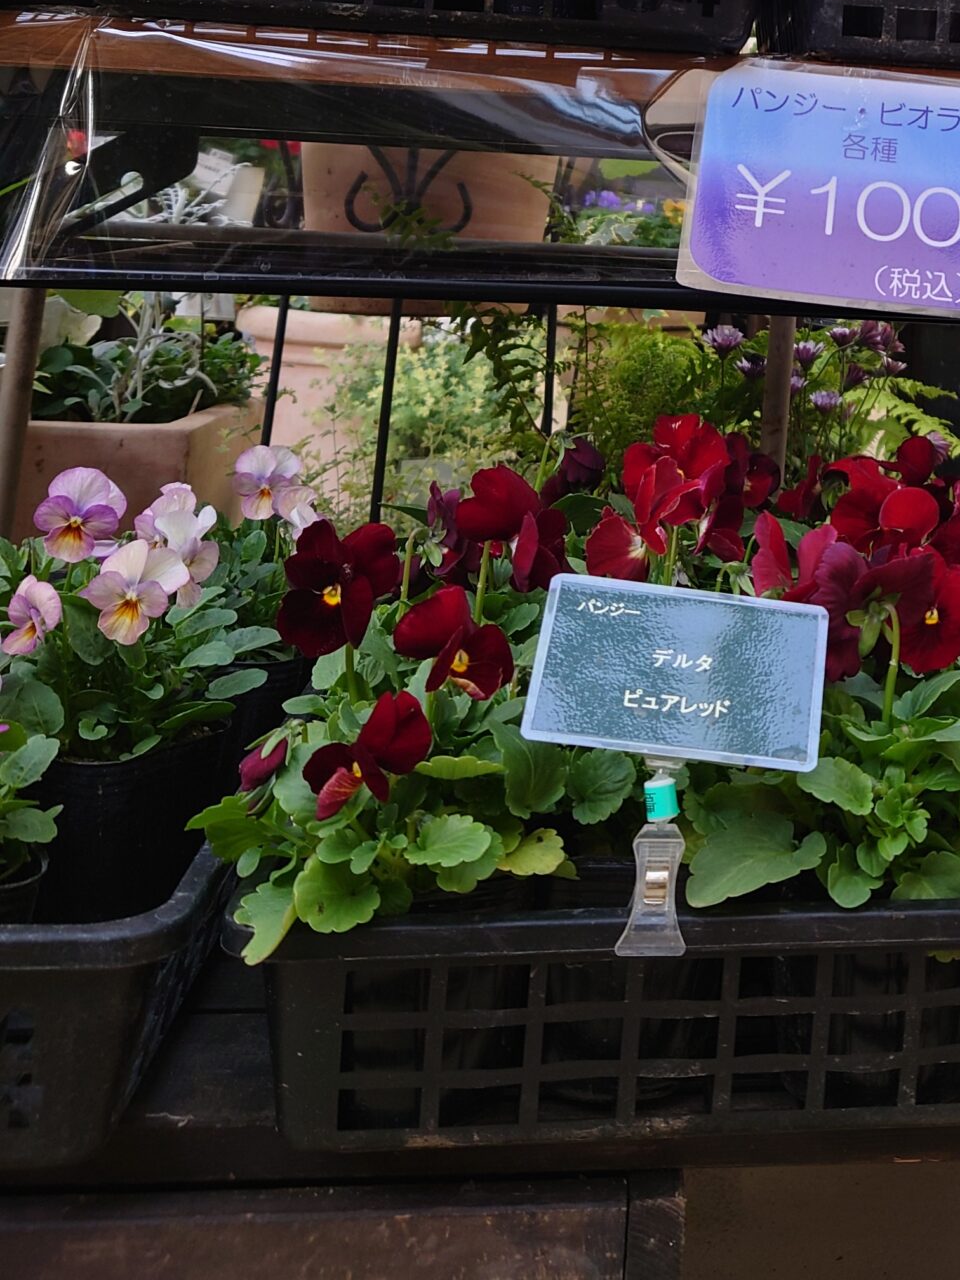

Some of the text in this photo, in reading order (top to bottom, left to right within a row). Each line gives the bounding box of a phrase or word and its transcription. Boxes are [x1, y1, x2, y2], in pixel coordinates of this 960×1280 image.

[842, 133, 899, 164] 各種
[577, 599, 641, 617] パンジー
[652, 649, 713, 672] デルタ
[623, 688, 731, 719] ピュアレッド
